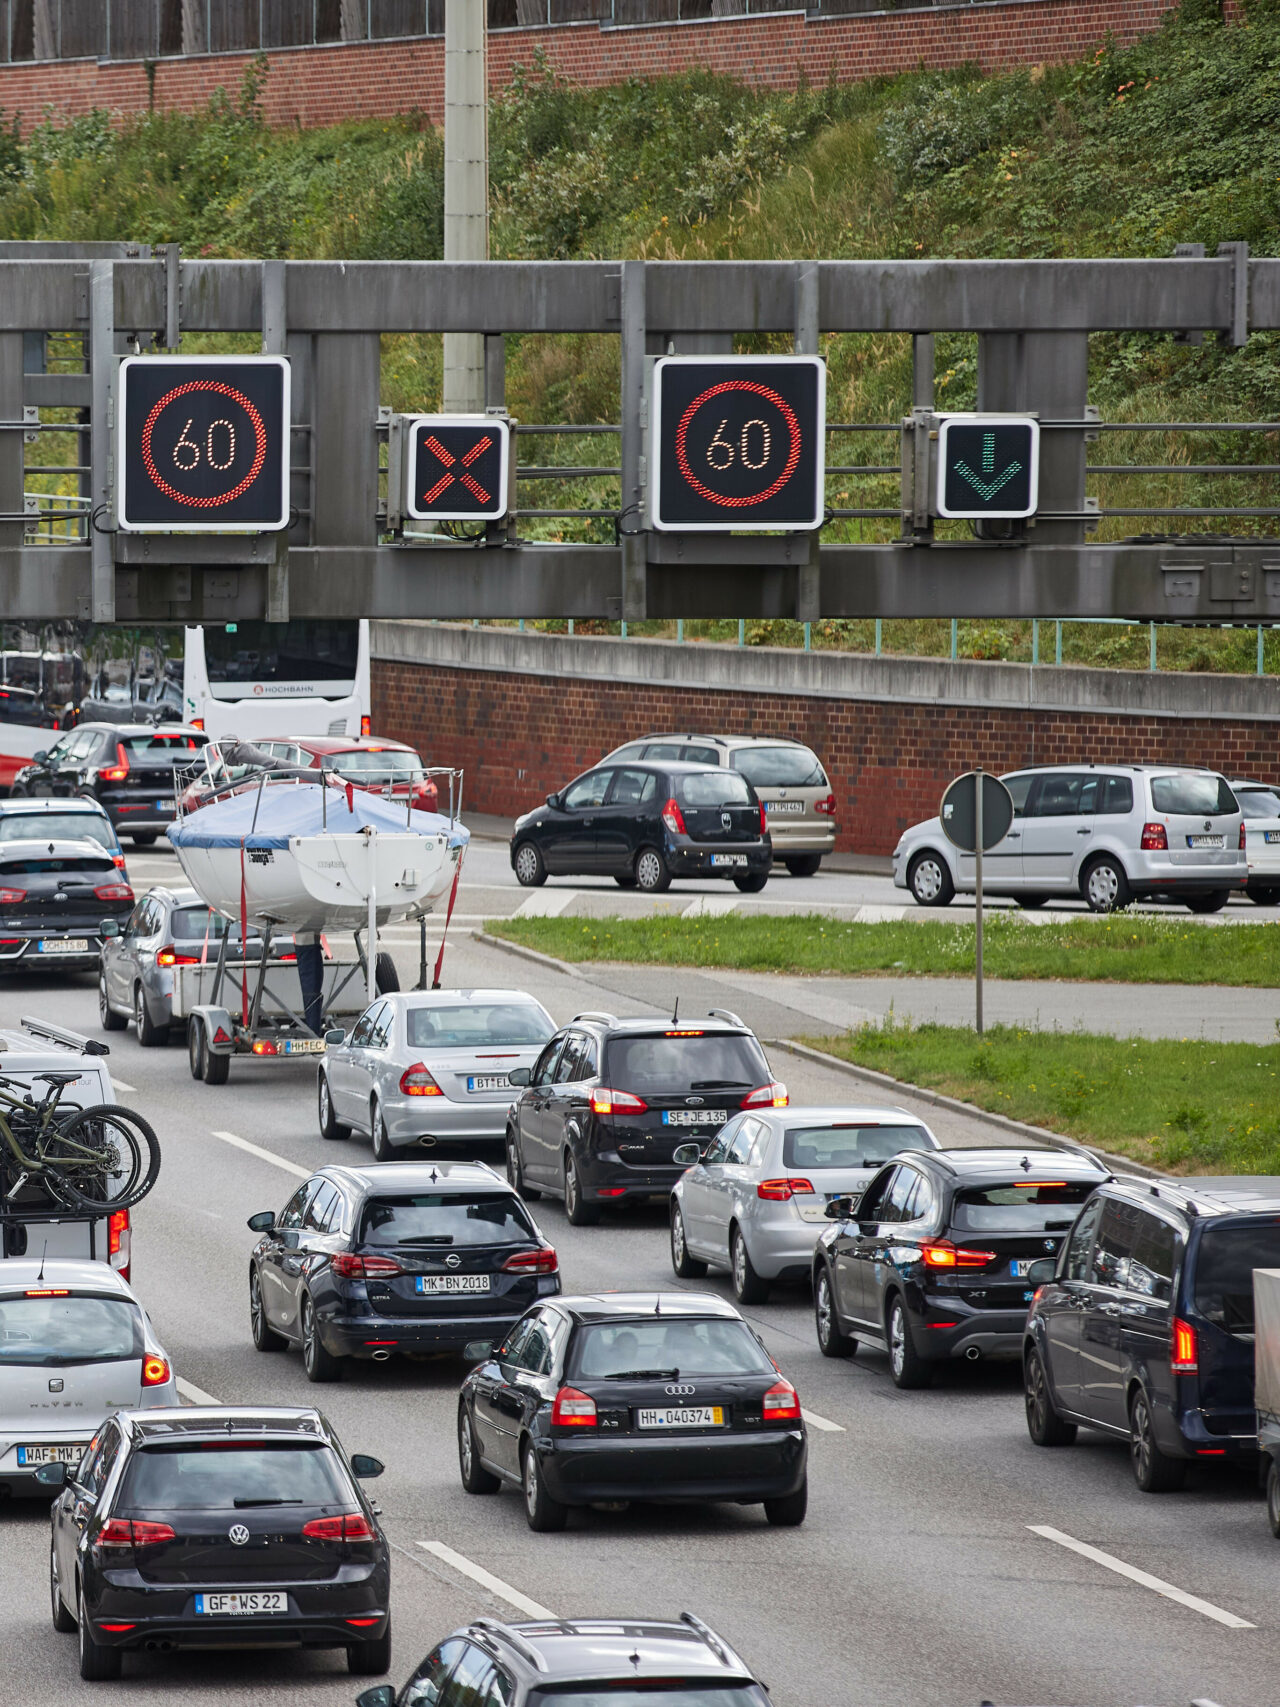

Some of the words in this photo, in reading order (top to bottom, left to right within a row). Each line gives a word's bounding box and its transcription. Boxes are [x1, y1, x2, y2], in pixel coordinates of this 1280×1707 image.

[172, 418, 236, 471] 60
[706, 418, 772, 471] 60
[265, 686, 314, 694] HOCHBAHN
[291, 1042, 304, 1051] HH
[309, 1041, 322, 1050] EC
[477, 1078, 490, 1088] BT
[496, 1077, 510, 1088] EL
[670, 1111, 683, 1123] SE
[690, 1111, 705, 1123] JE
[706, 1111, 727, 1123] 135
[423, 1278, 438, 1290] MK
[445, 1277, 460, 1290] BN
[461, 1276, 489, 1289] 2018
[640, 1410, 657, 1425] HH
[665, 1408, 712, 1424] 040374
[26, 1449, 49, 1461] WAF
[58, 1447, 74, 1460] MW
[209, 1594, 229, 1611] GF
[239, 1594, 259, 1610] WS
[261, 1594, 281, 1610] 22
